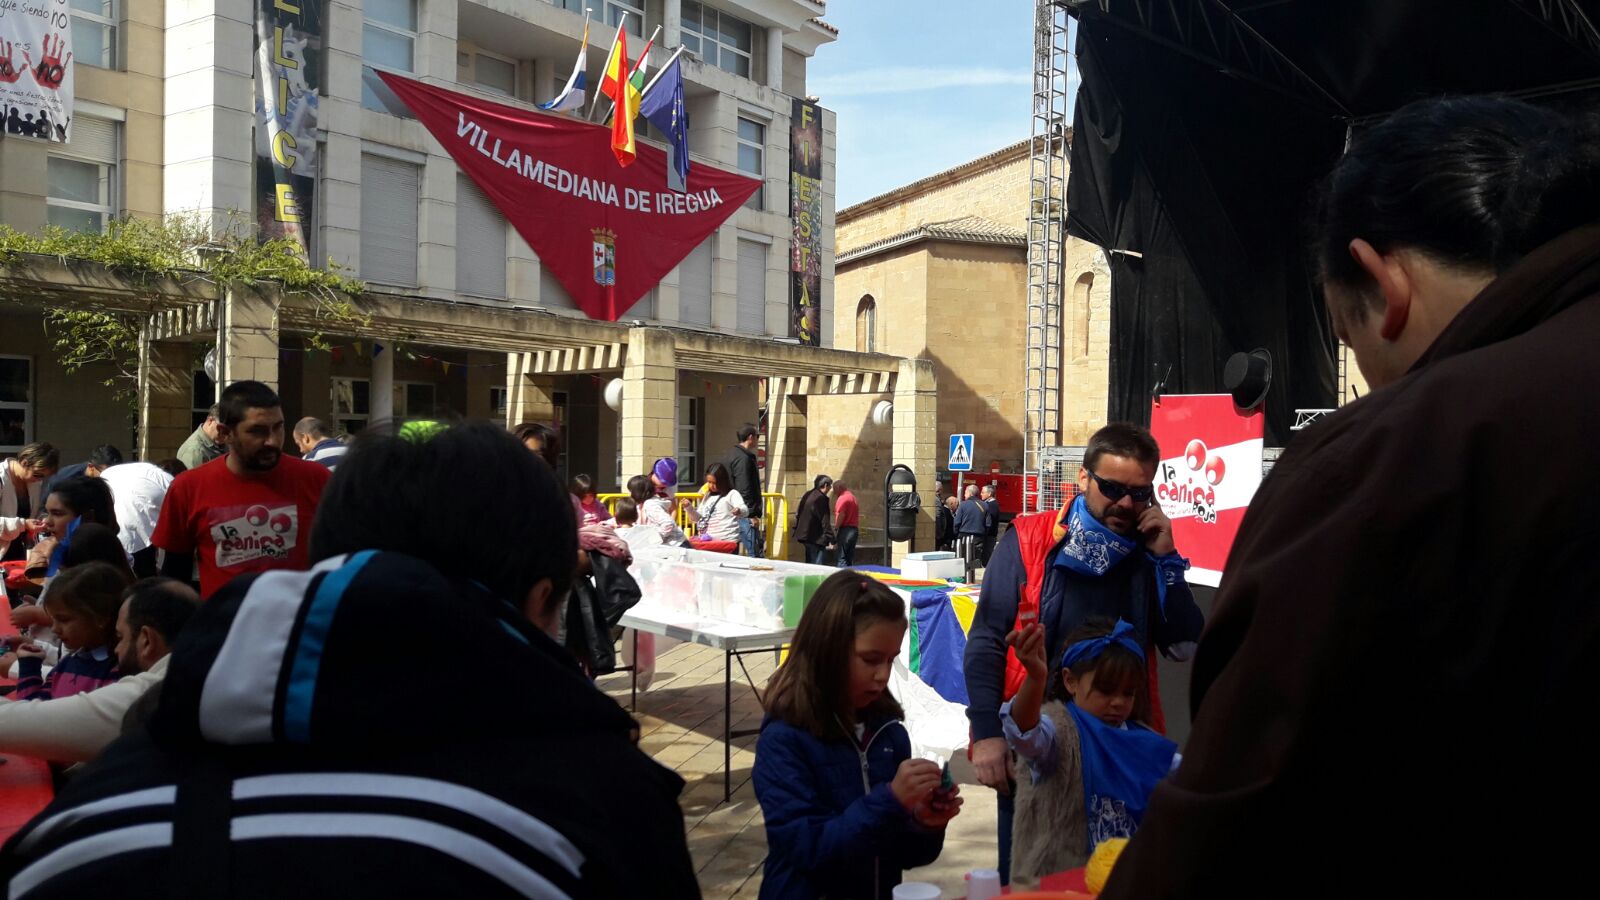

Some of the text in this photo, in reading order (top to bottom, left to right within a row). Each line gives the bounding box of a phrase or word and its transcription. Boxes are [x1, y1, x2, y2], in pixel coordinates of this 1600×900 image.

[51, 9, 67, 29] no
[15, 42, 31, 50] es
[37, 60, 65, 84] no
[455, 111, 724, 215] VILLAMEDIANA DE IREGUA
[799, 105, 814, 341] FIESTAS
[1162, 462, 1176, 483] la
[220, 525, 238, 540] la
